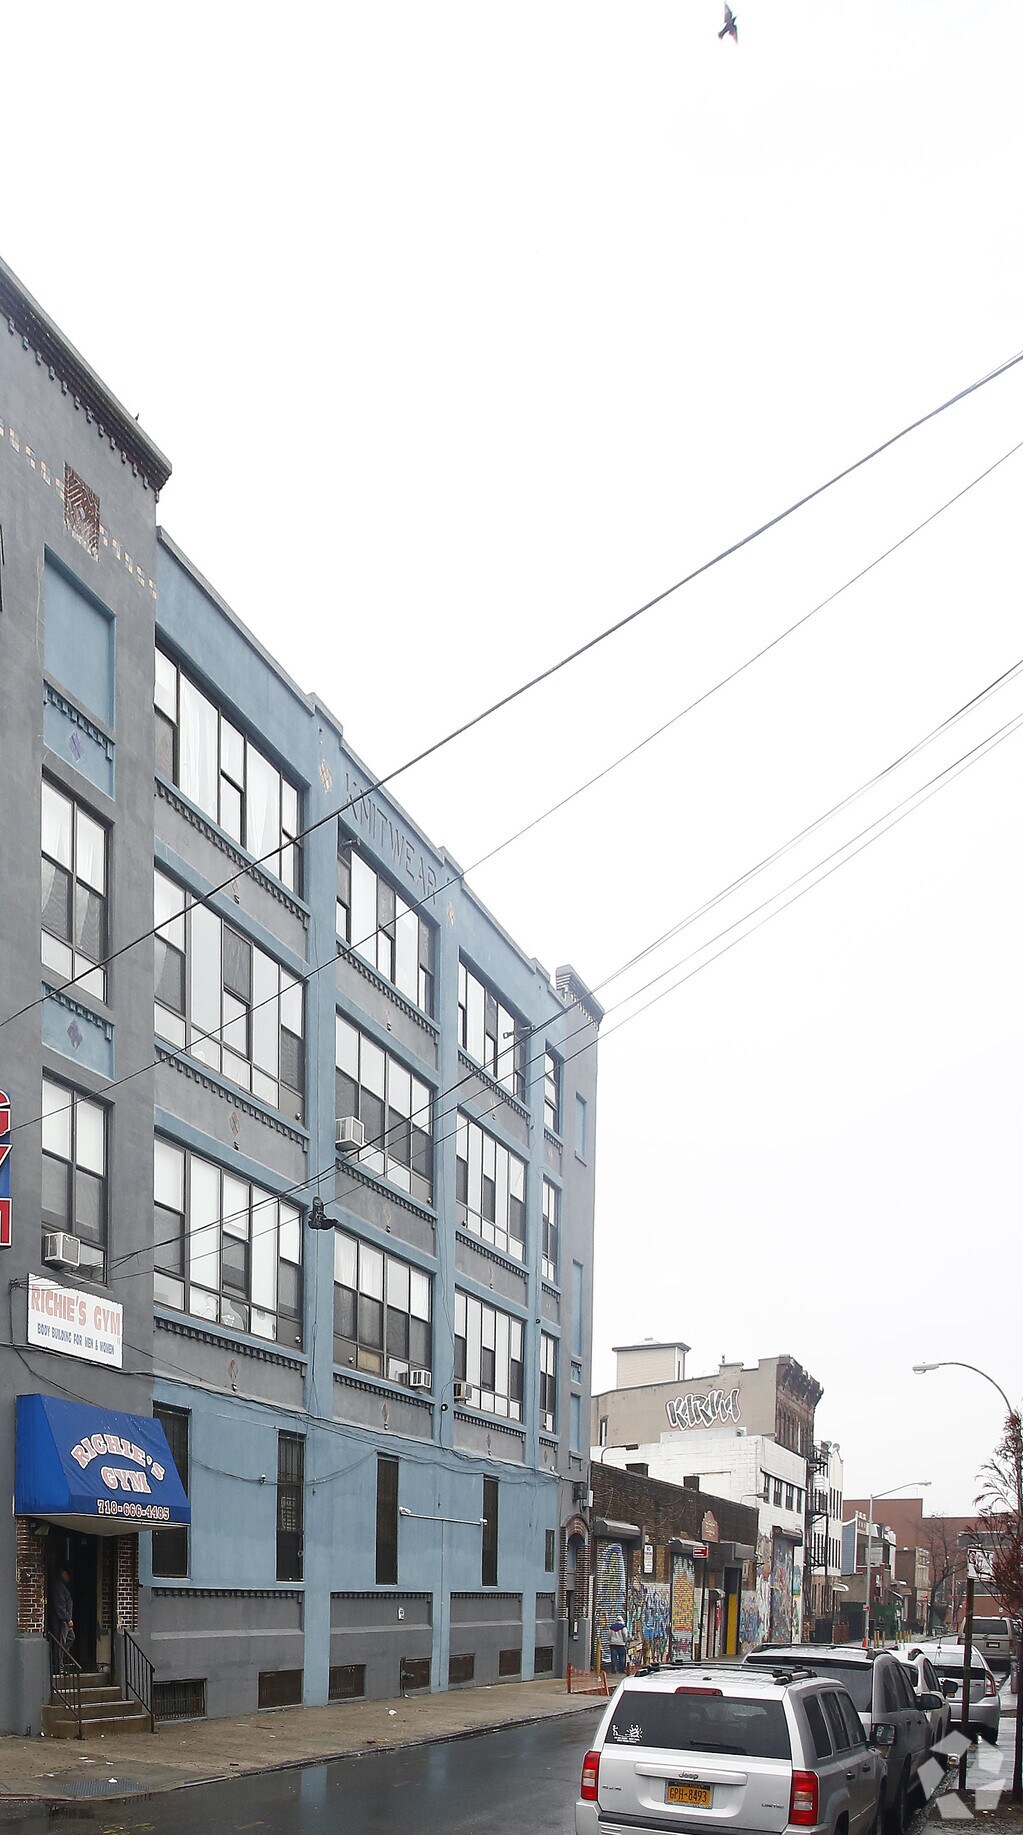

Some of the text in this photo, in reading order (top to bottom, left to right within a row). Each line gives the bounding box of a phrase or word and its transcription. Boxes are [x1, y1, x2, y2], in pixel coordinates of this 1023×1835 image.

[344, 772, 437, 906] KNITWEAR
[31, 1284, 121, 1336] RICHIE'S GYM
[37, 1322, 50, 1337] BODY
[51, 1326, 72, 1344] BUILDING
[73, 1332, 83, 1347] FOR
[99, 1341, 115, 1355] WOMEN
[70, 1433, 166, 1481] RICHIE'S
[100, 1466, 152, 1494] GYM
[97, 1499, 170, 1520] 718-666-4485
[678, 1770, 699, 1780] Jeep
